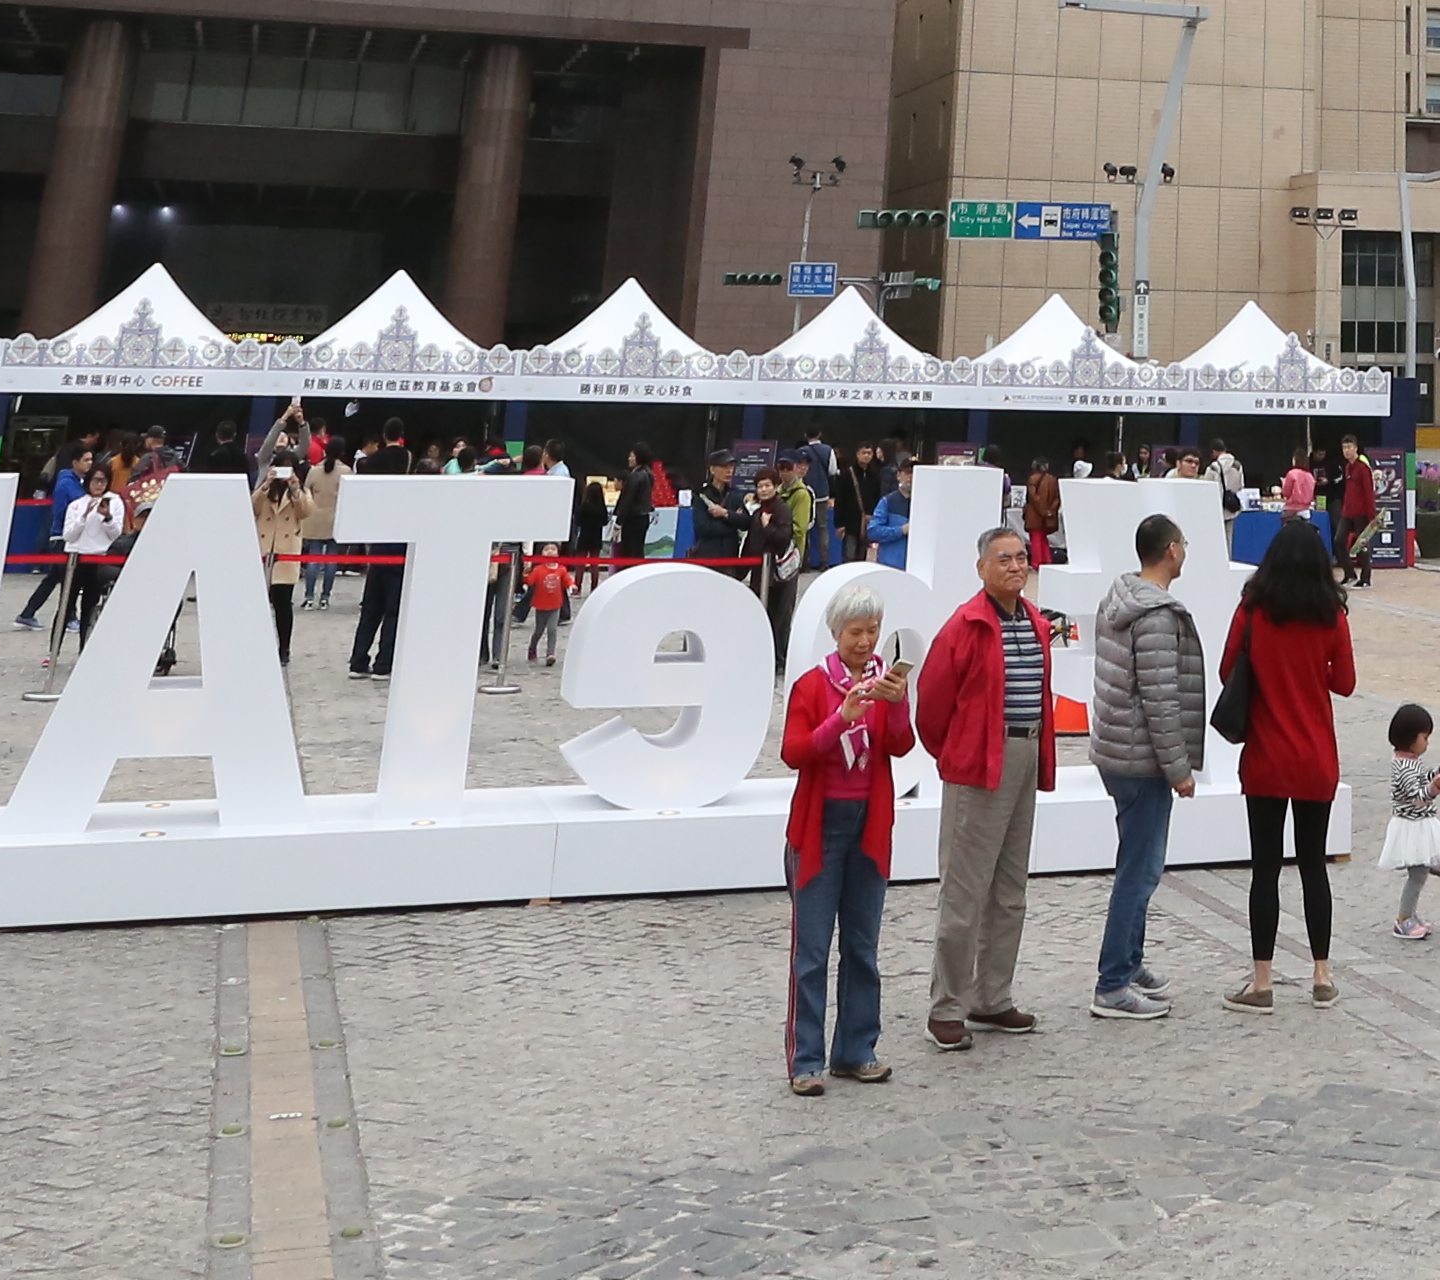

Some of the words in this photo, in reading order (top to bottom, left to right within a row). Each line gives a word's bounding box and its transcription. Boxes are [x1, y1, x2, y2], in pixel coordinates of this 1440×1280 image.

[61, 374, 146, 387] 全聯福利中心
[151, 375, 204, 387] COFFEE
[644, 385, 693, 397] 安心好食
